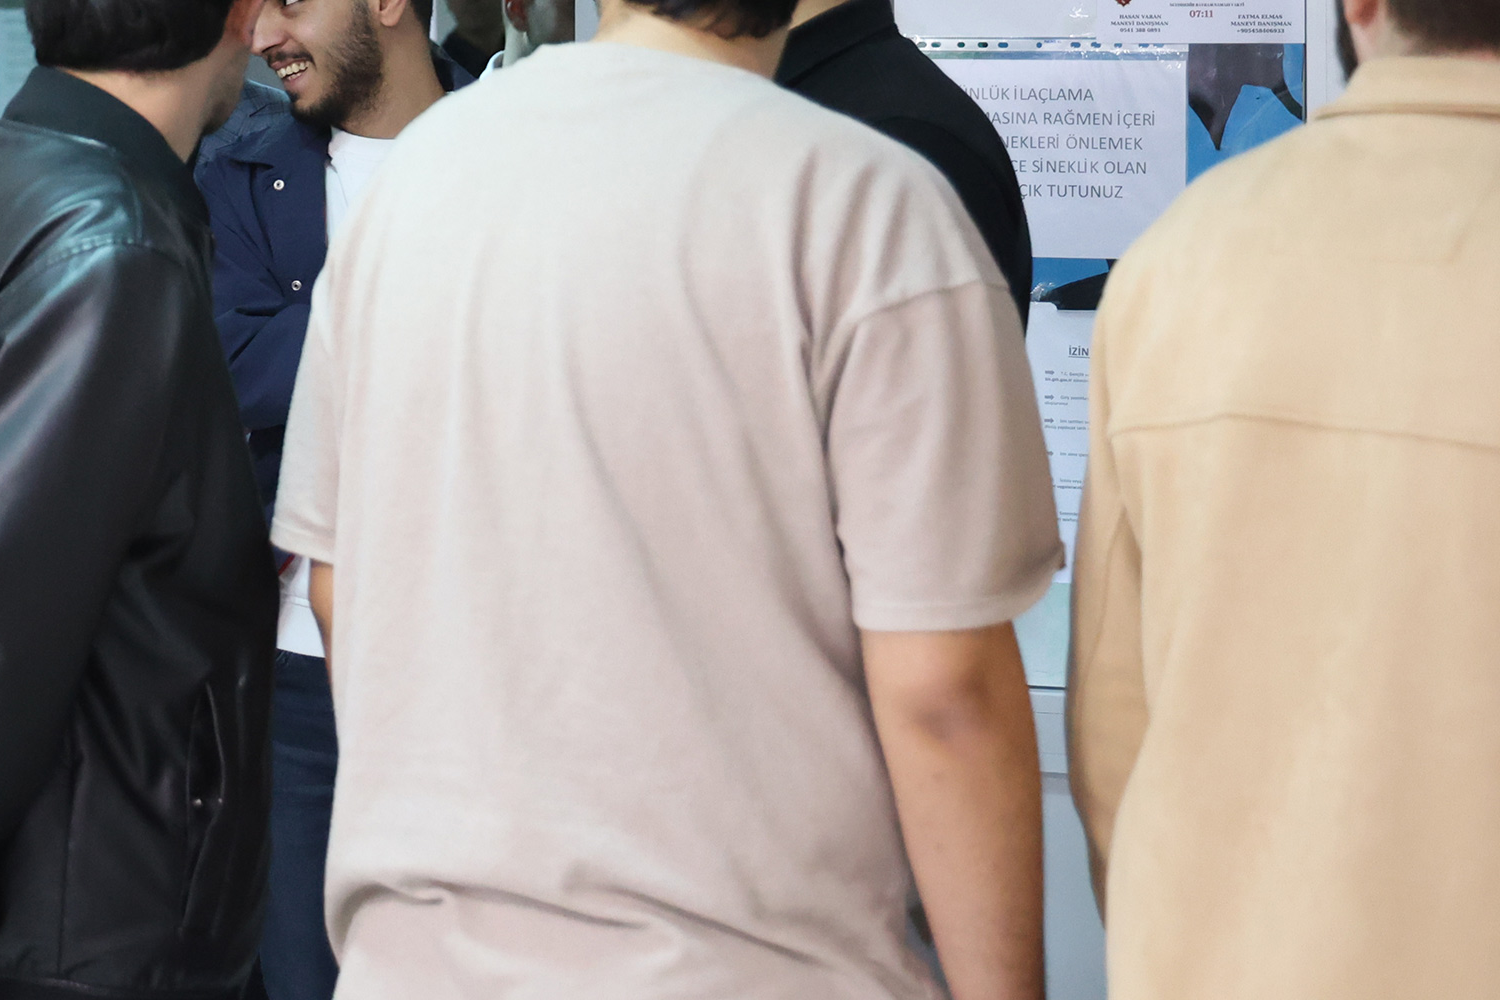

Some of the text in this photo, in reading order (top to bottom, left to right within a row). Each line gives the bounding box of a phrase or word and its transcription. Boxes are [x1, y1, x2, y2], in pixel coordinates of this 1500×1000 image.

[1189, 9, 1214, 18] 07:11
[1014, 84, 1094, 104] İLAÇLAMA
[1043, 109, 1112, 126] RAĞMEN
[1117, 110, 1155, 129] İÇERİ
[1066, 134, 1143, 151] ÖNLEMEK
[1032, 157, 1099, 174] SİNEKLİK
[1103, 160, 1147, 175] OLAN
[1046, 184, 1123, 199] TUTUNUZ
[1068, 345, 1090, 357] İZİN
